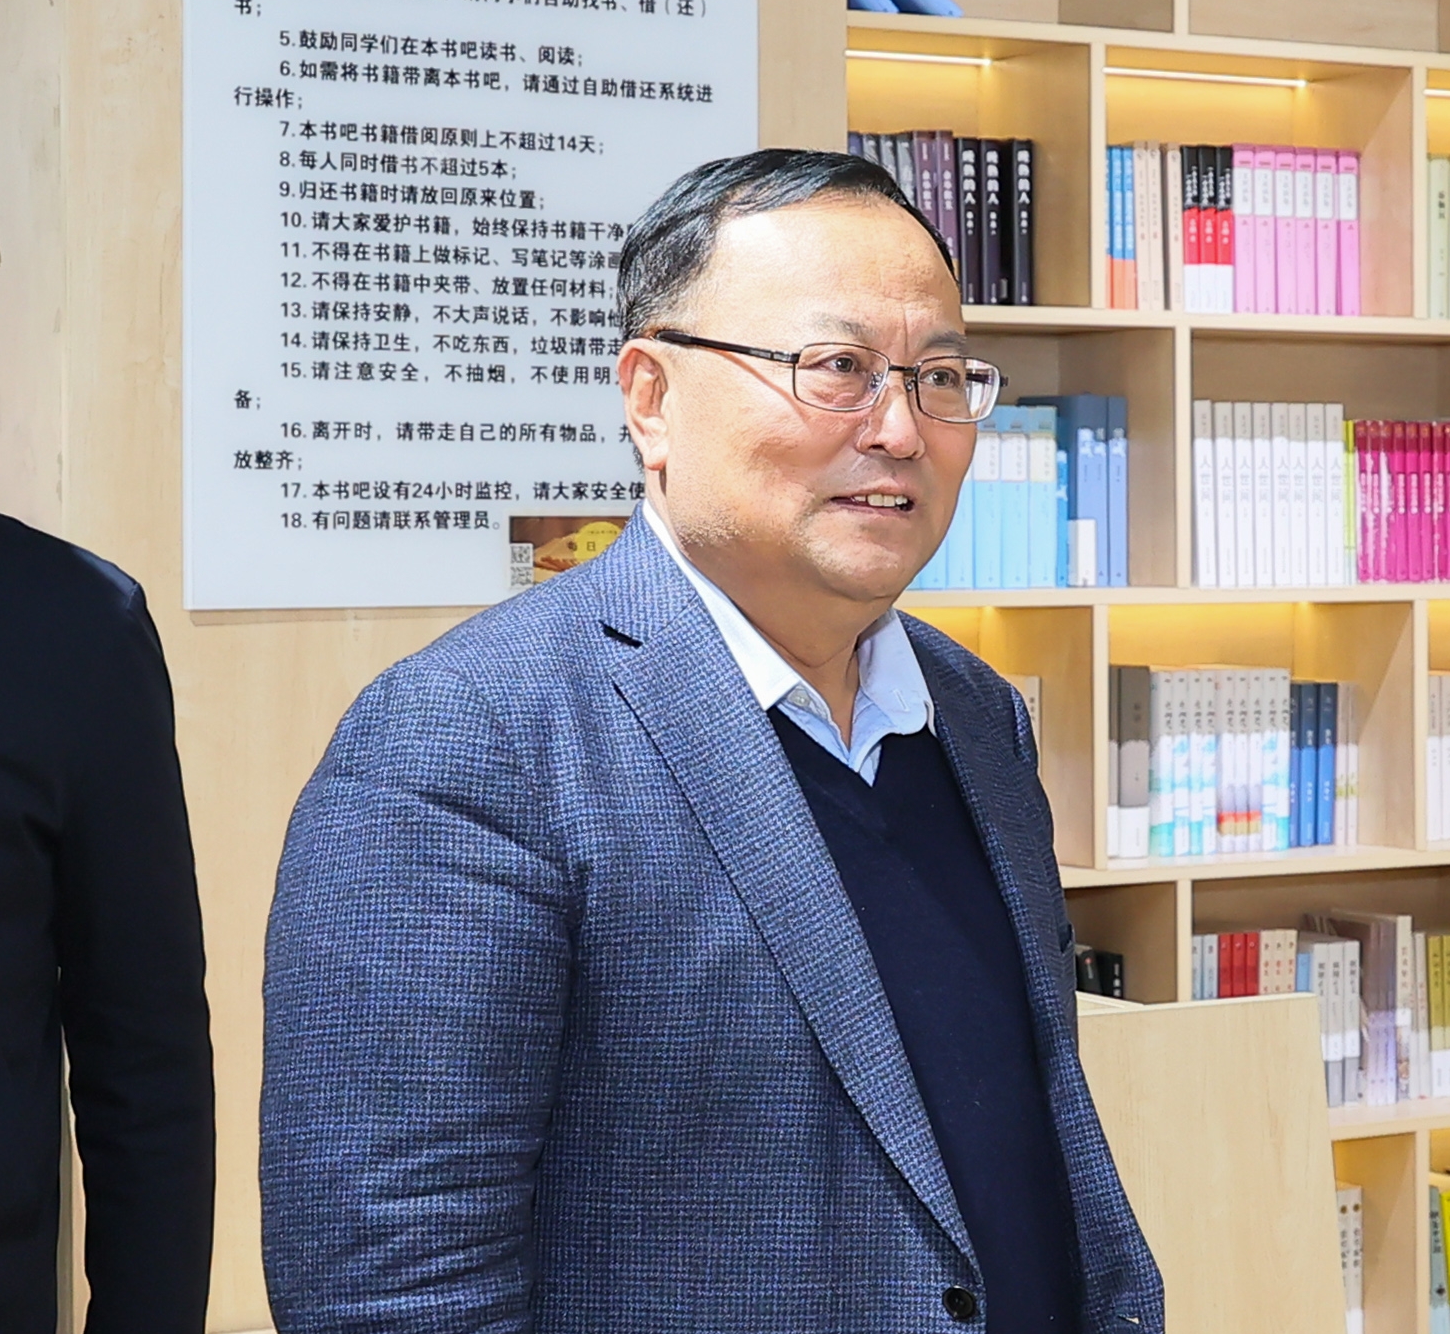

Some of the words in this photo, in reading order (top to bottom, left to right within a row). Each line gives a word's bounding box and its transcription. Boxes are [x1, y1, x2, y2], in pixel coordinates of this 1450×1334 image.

[233, 85, 303, 110] 行操作；
[233, 389, 261, 410] 备；
[233, 449, 302, 470] 放整齐；
